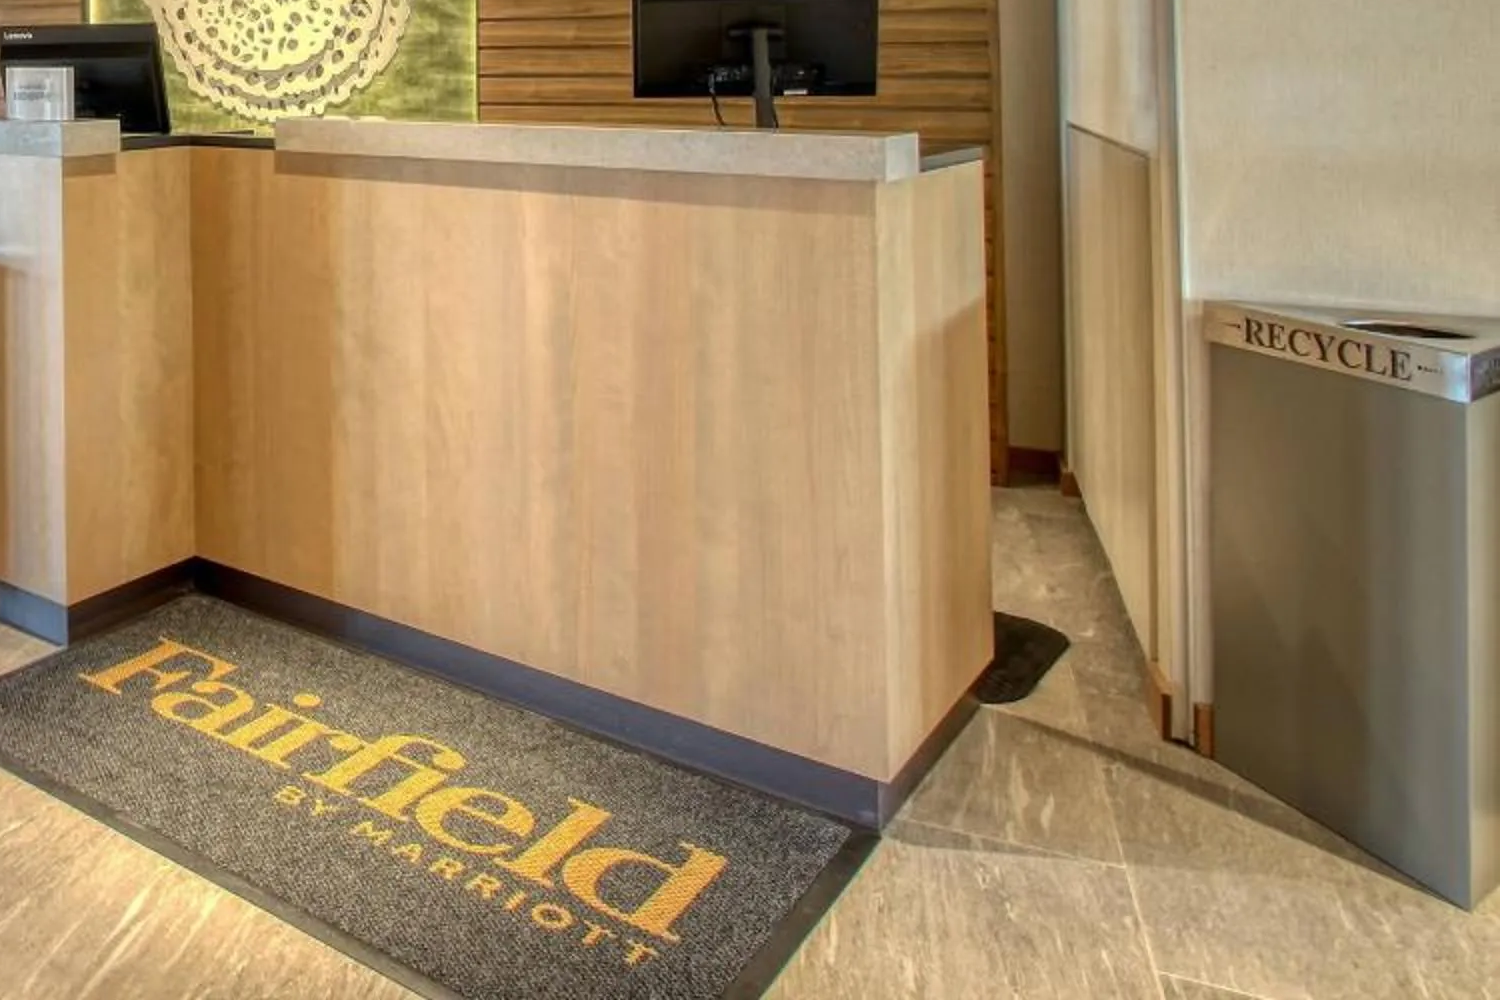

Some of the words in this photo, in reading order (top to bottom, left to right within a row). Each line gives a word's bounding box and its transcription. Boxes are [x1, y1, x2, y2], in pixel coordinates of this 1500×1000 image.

[1243, 316, 1413, 382] RECYCLE
[79, 635, 729, 944] Fairfield
[273, 785, 336, 817] BY
[352, 820, 661, 967] MARRIOTT
